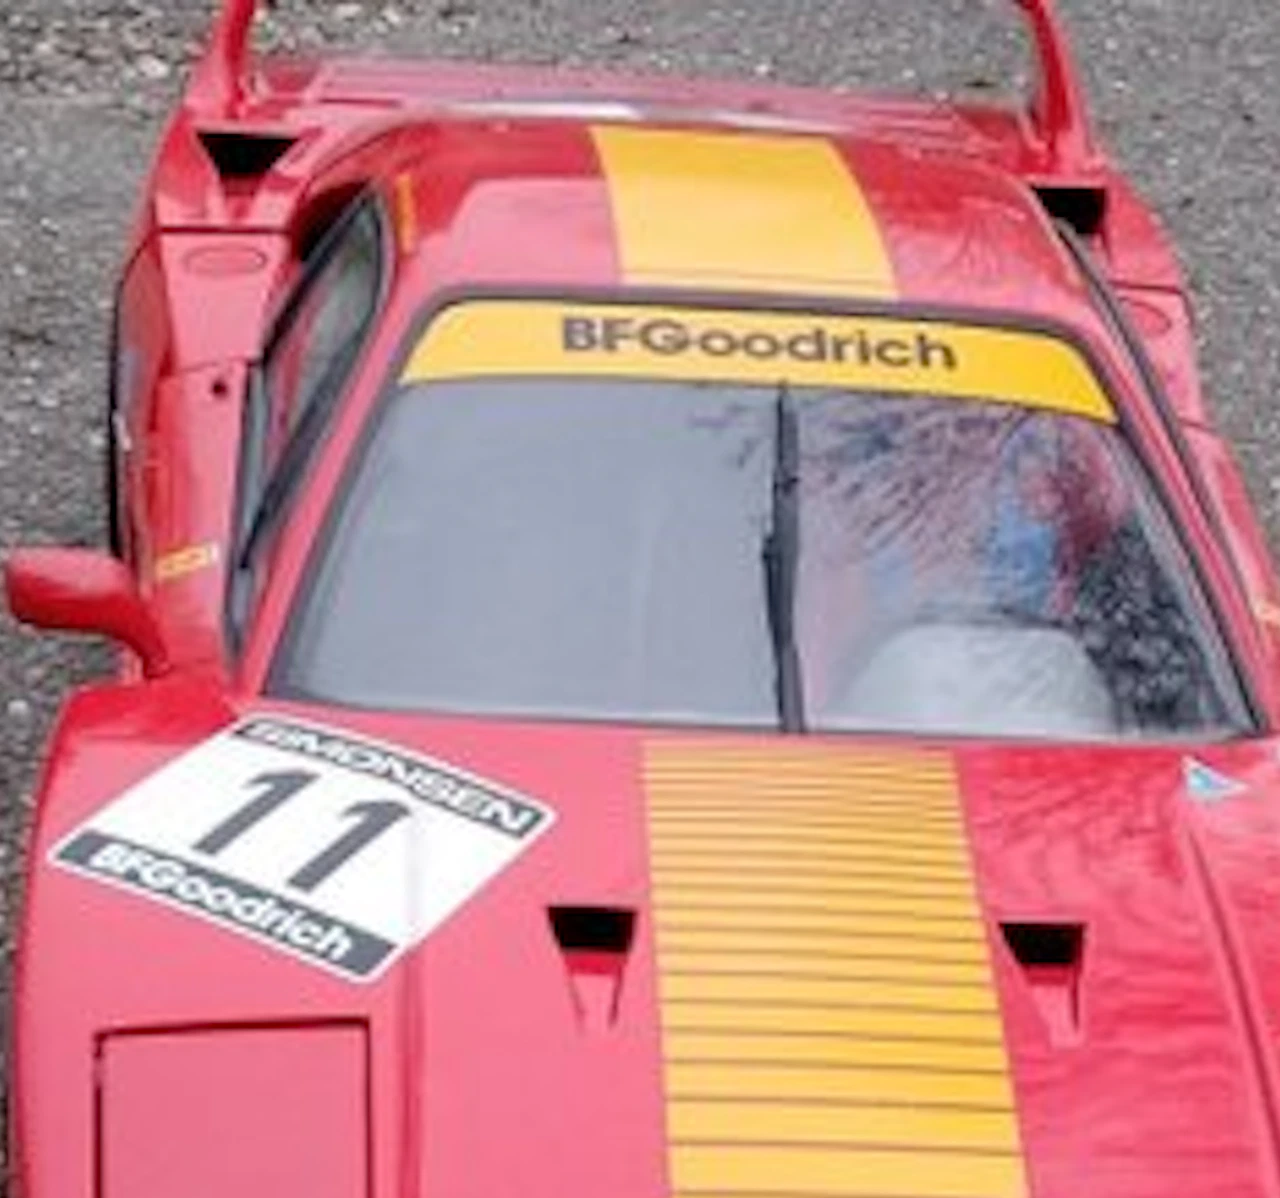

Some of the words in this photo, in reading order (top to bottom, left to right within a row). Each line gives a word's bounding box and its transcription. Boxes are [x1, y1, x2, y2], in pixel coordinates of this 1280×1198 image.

[560, 315, 960, 372] BFGoodrich
[191, 767, 412, 897] 11
[240, 716, 535, 832] SIMONSEN
[89, 841, 355, 962] BFGoodrich
